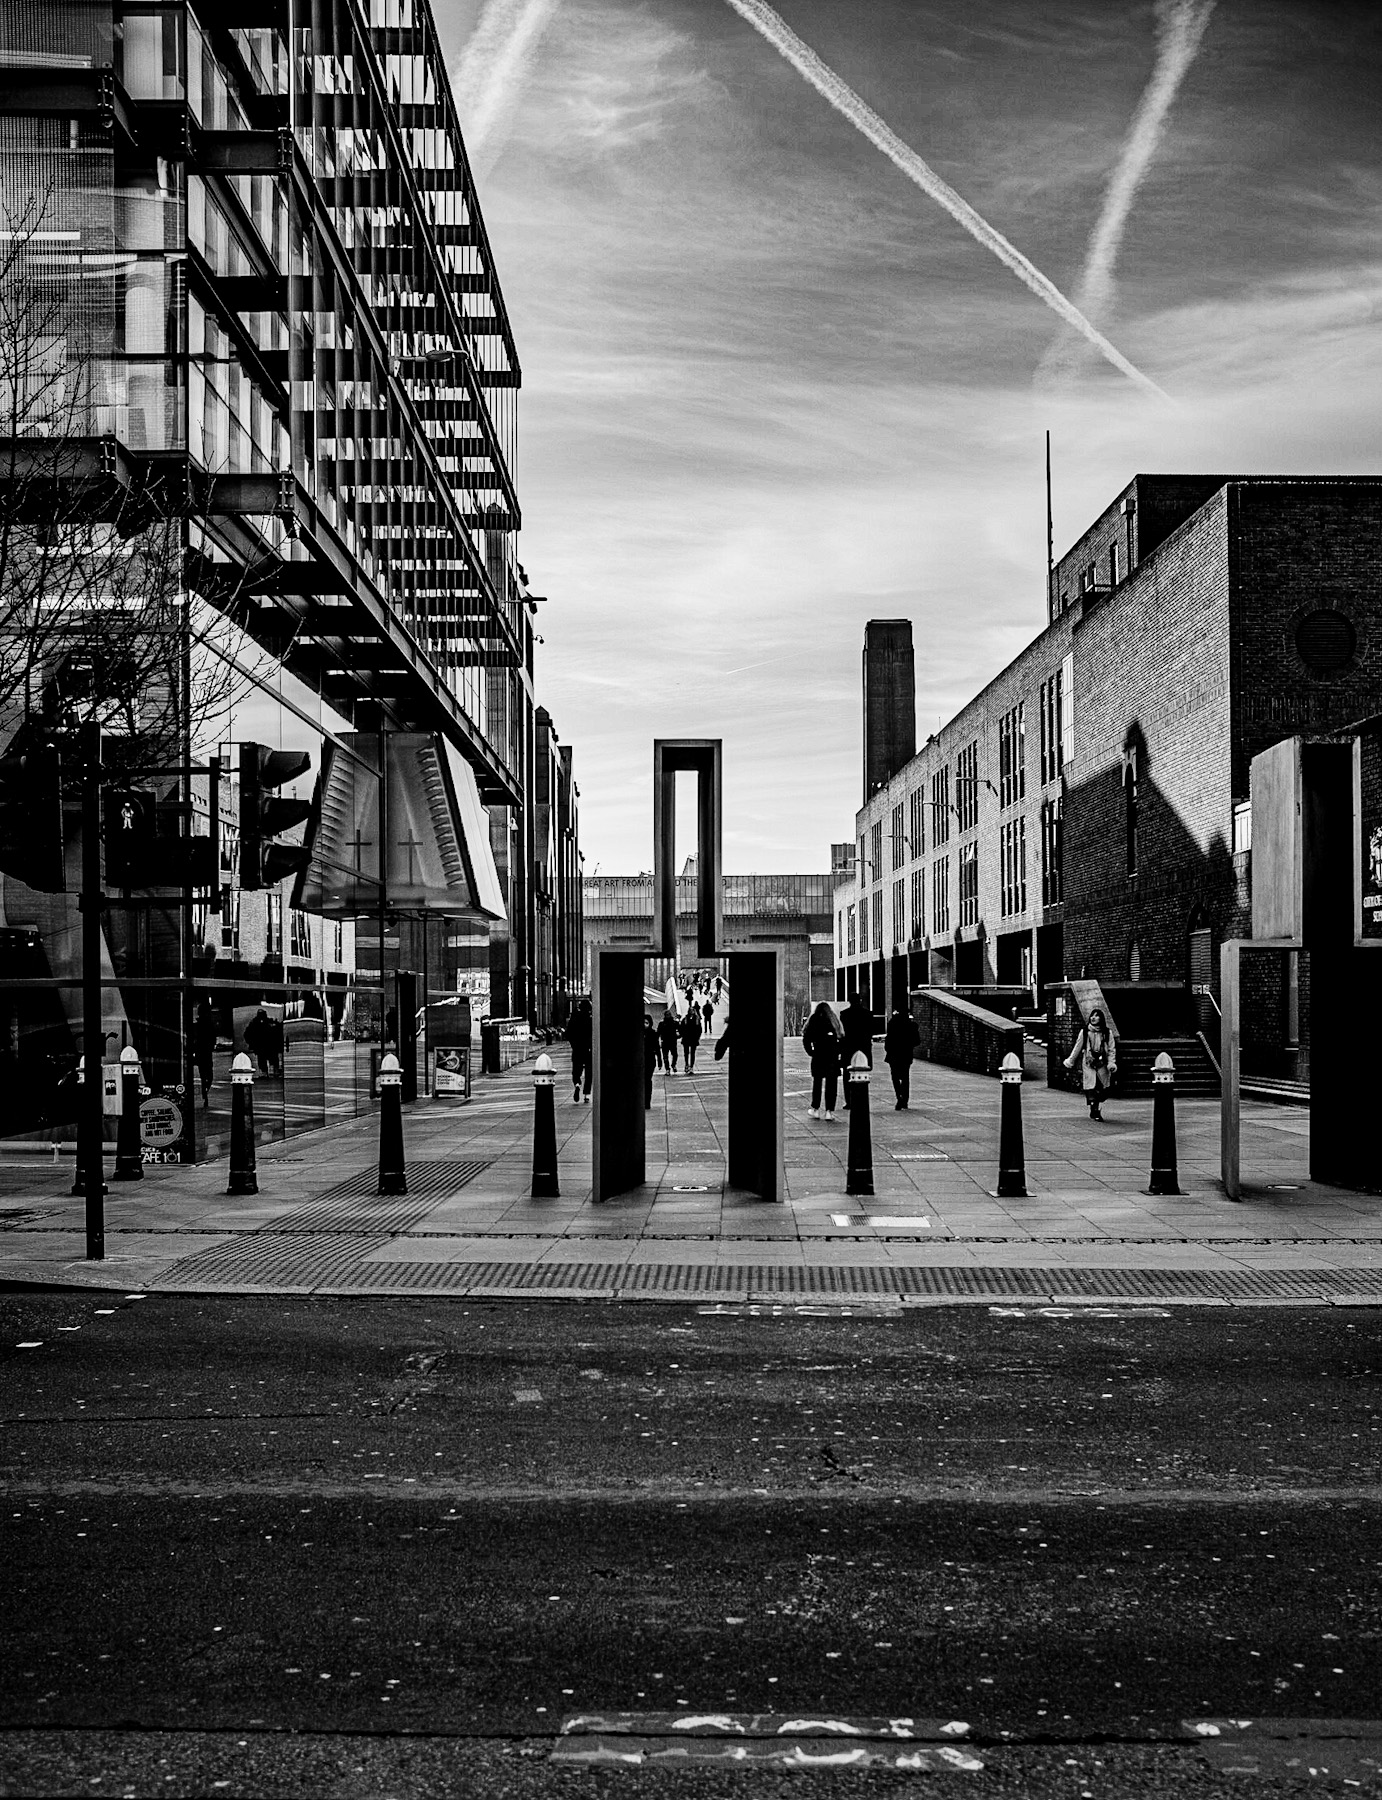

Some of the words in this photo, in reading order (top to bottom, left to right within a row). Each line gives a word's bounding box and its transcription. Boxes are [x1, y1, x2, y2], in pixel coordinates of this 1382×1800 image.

[584, 879, 602, 888] REAT
[604, 879, 619, 887] ART
[622, 879, 645, 887] FROM
[163, 1151, 181, 1163] 101
